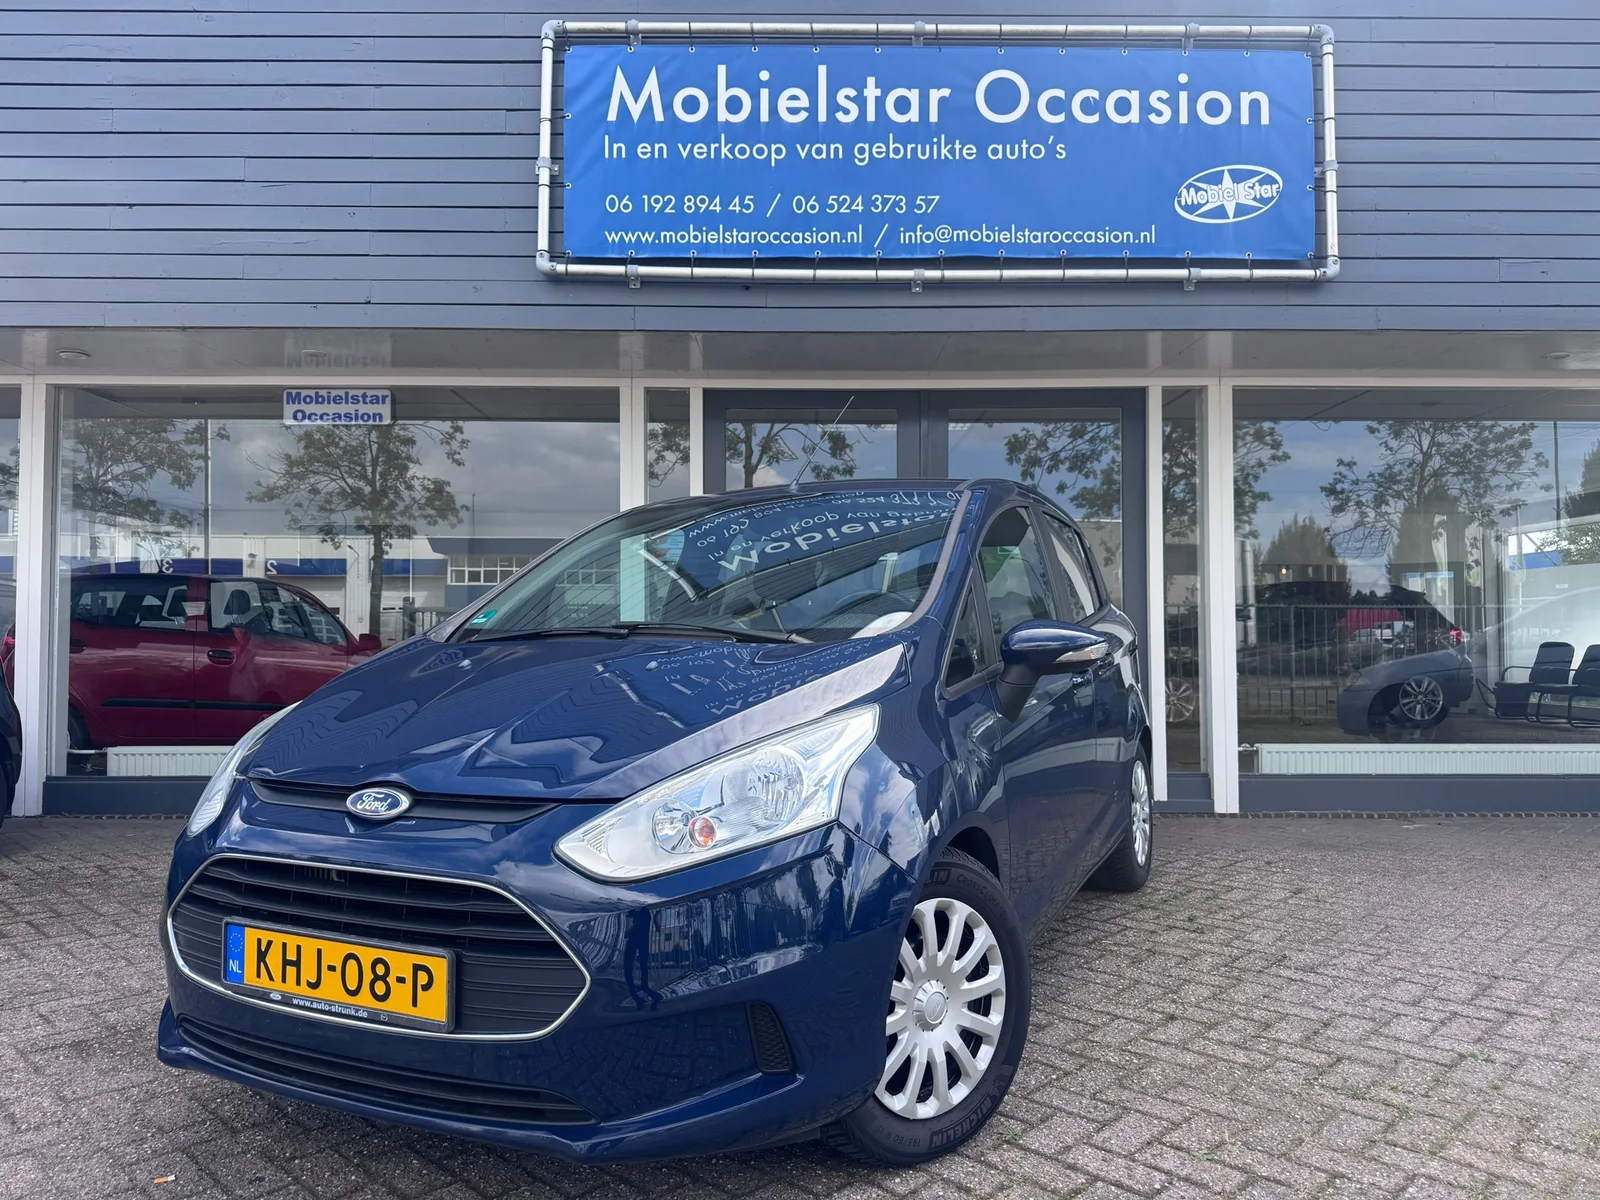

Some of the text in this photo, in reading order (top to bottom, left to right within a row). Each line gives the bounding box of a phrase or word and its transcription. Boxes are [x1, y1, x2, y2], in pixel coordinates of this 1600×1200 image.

[606, 64, 1270, 126] Mobielstar Occasion
[604, 134, 626, 159] In
[637, 143, 667, 159] en
[677, 133, 787, 167] verkoop
[796, 143, 843, 160] van
[854, 133, 977, 166] gebruikte
[605, 193, 940, 218] 06 192 894 45 / 06 524 373 57
[1181, 181, 1280, 206] Mobiel Star
[604, 223, 1156, 248] www.mobielstaroccasion.nl / info@mobielstaroccasion.nl
[285, 391, 389, 405] Mobielstar
[292, 409, 384, 423] Occasion
[356, 792, 392, 812] Ford
[228, 958, 242, 974] NL
[255, 936, 435, 1009] KHJ-08-P
[292, 997, 369, 1018] www.auto-strunk.de
[930, 1095, 993, 1148] MICHELIN
